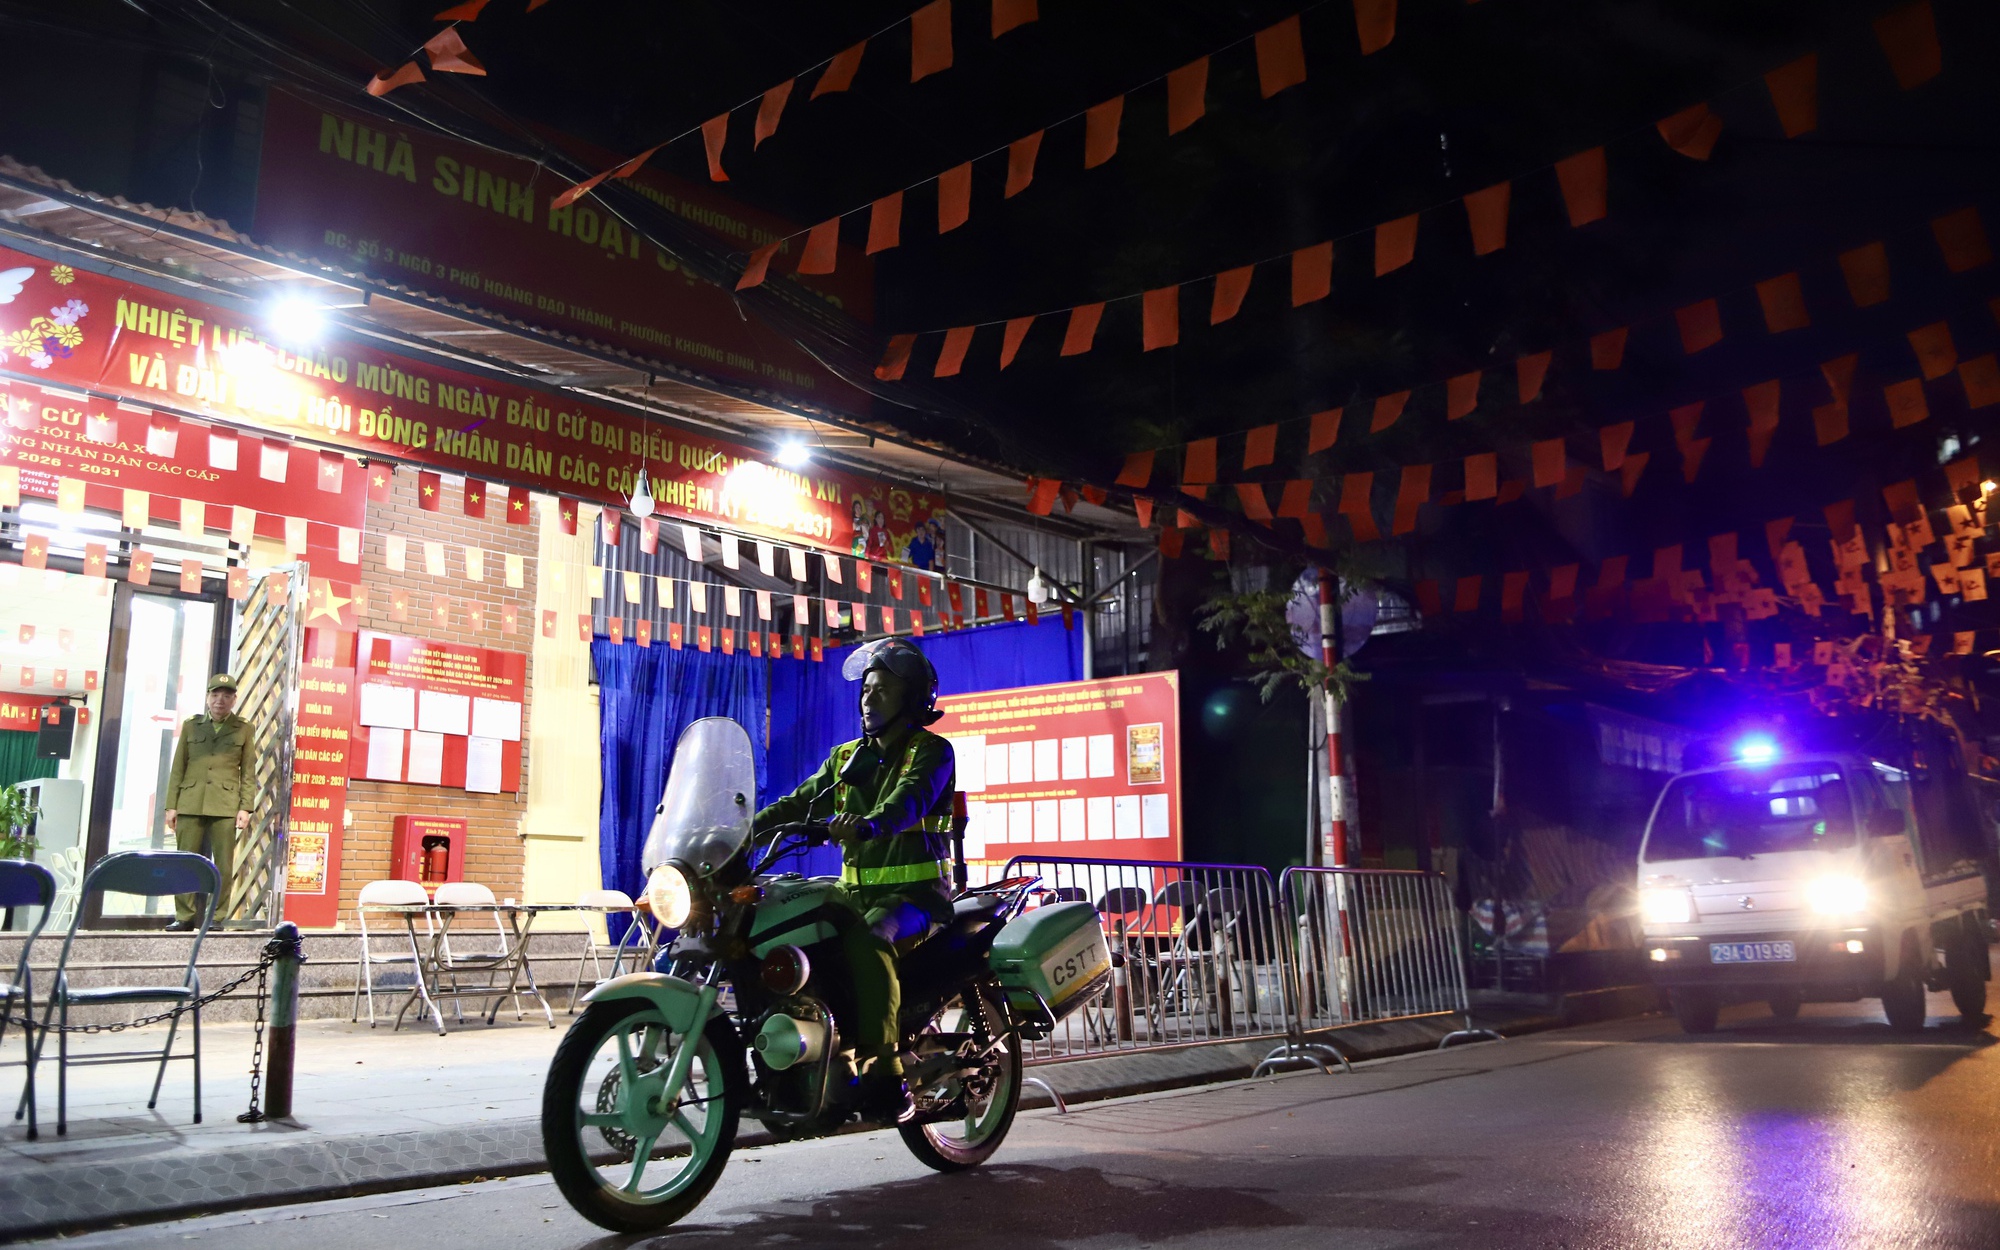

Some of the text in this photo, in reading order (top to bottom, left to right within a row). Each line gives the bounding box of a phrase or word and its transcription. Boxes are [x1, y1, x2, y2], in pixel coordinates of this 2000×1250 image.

[319, 112, 417, 184] NHÀ
[432, 155, 536, 224] SINH
[385, 248, 395, 263] 3
[436, 264, 446, 279] 3
[484, 278, 534, 306] HOÀNG
[537, 293, 566, 316] ĐẠO
[42, 407, 83, 426] CỬ
[115, 298, 204, 349] NHIỆT
[356, 361, 430, 405] MỪNG
[438, 382, 500, 420] NGÀY
[506, 395, 550, 433] BẦU
[557, 409, 588, 442] CỬ
[591, 420, 624, 454] ĐẠI
[630, 428, 673, 464] BIỂU
[679, 444, 728, 477] QUỐC
[816, 478, 842, 504] XVI
[130, 352, 168, 391] VÀ
[176, 364, 227, 408] ĐẠI
[307, 395, 351, 435] HỘI
[359, 405, 428, 449] ĐỒNG
[434, 426, 499, 465] NHÂN
[506, 441, 552, 477] DÂN
[559, 449, 601, 488] CÁC
[653, 477, 713, 514] NHIỆM
[17, 451, 62, 467] 2026
[80, 463, 120, 478] 2031
[41, 441, 99, 460] NHÂN
[102, 452, 142, 468] DÂN
[146, 461, 182, 475] CÁC
[186, 469, 220, 482] CẤP
[306, 724, 320, 737] BIỂU
[321, 727, 331, 740] HỘI
[332, 727, 348, 740] ĐỒNG
[305, 749, 317, 761] DÂN
[318, 749, 331, 762] CÁC
[331, 750, 344, 763] CẤP
[311, 775, 326, 785] 2026
[330, 776, 344, 786] 2031
[319, 797, 330, 811] HỘI
[1053, 943, 1096, 986] CSTT
